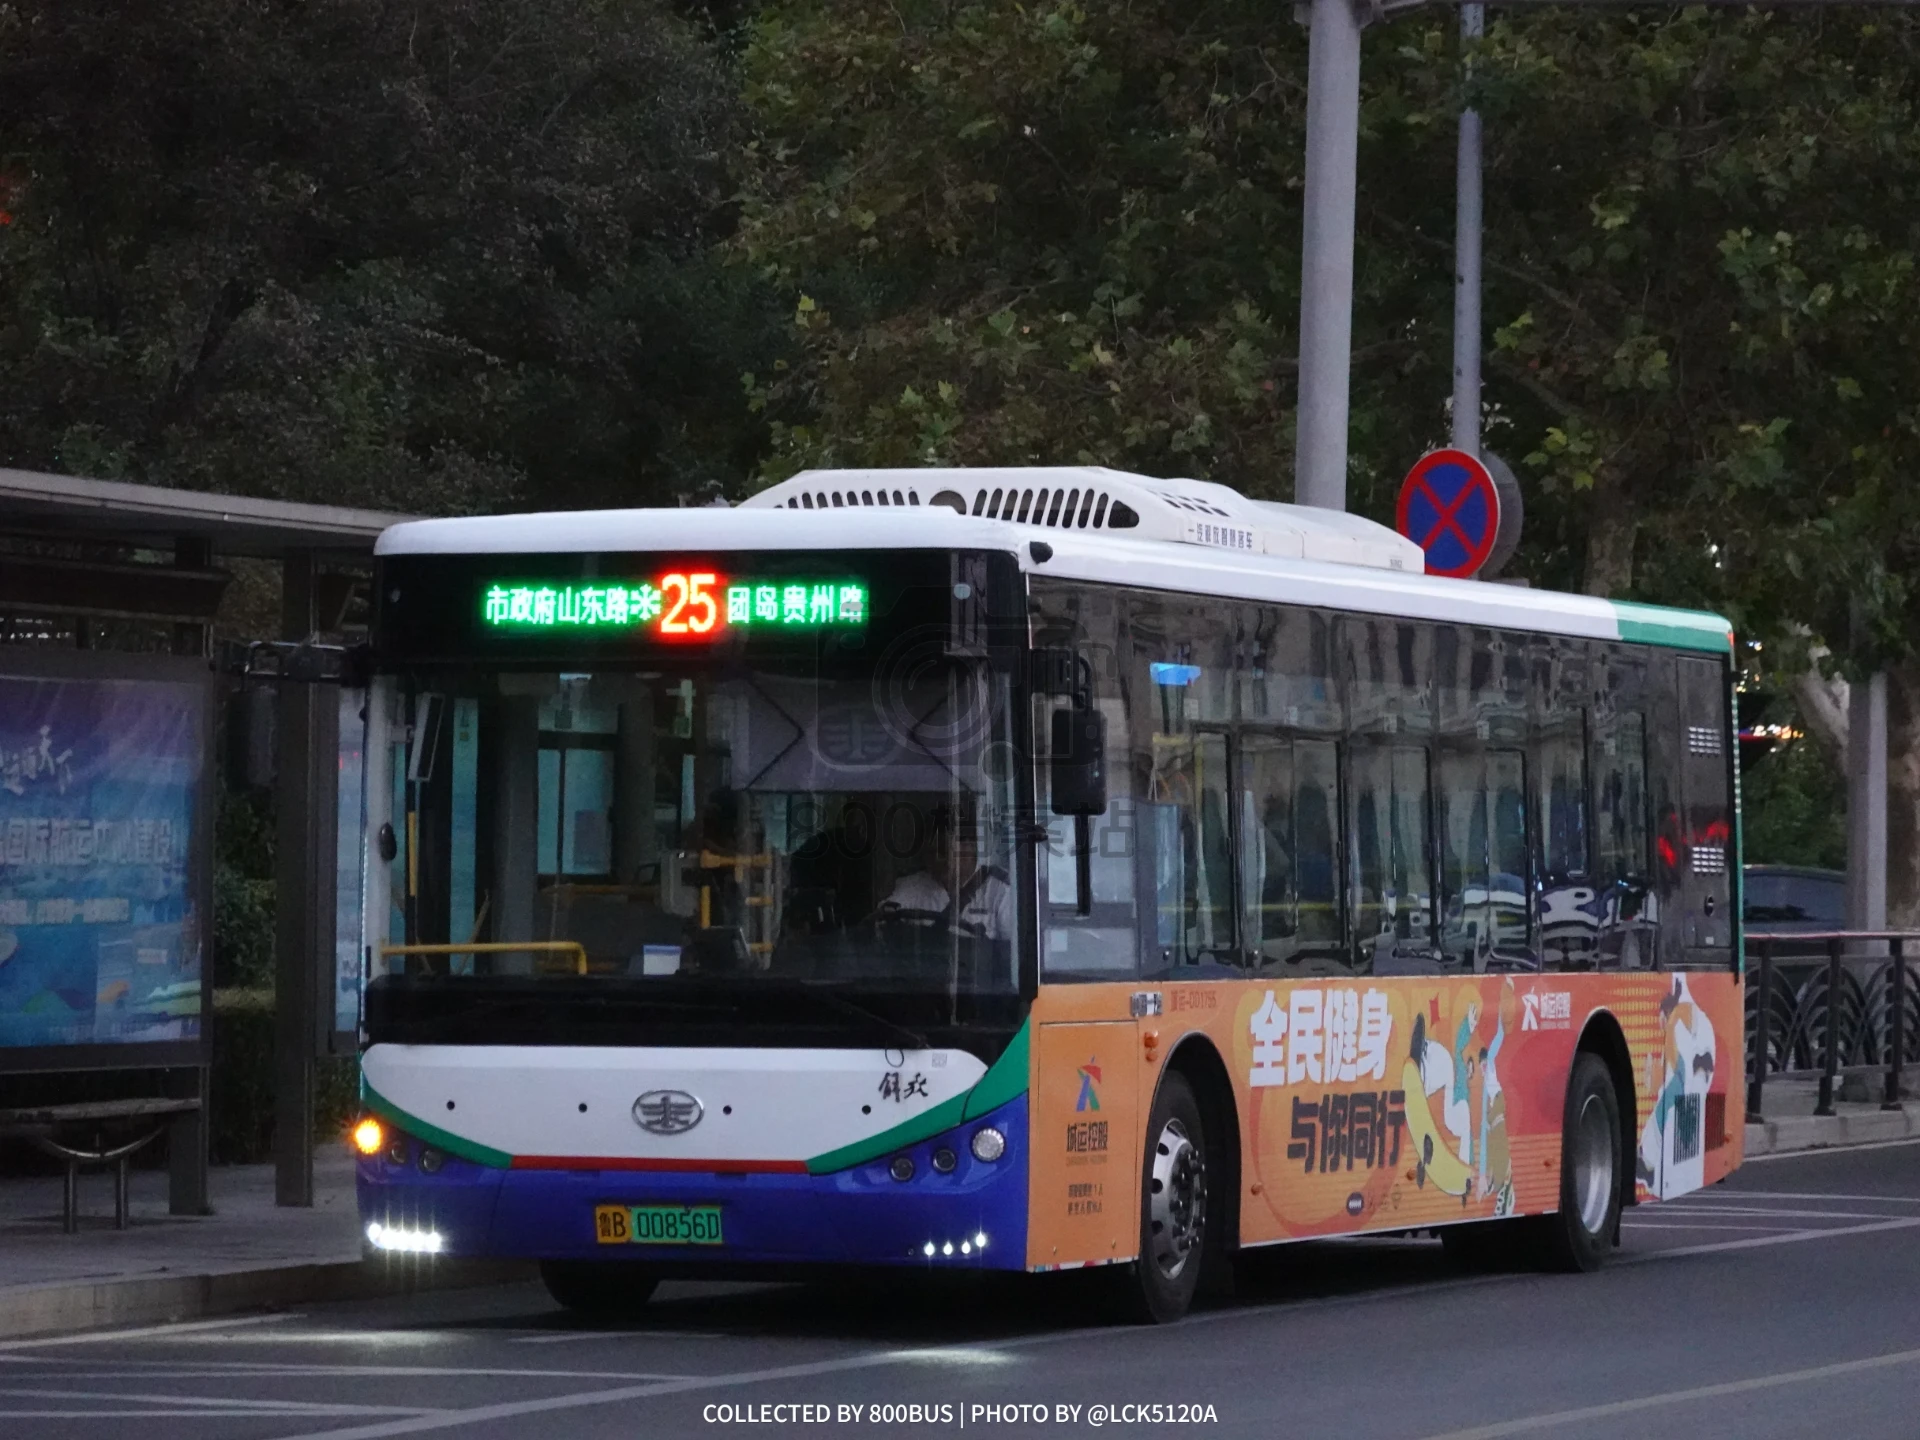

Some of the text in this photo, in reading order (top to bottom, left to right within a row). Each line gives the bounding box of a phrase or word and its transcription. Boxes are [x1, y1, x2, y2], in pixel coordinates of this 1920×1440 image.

[486, 573, 863, 633] 市政府山东路 25 团岛贵州路
[1249, 988, 1393, 1087] 全民健身
[1066, 1121, 1108, 1152] 城运控股
[1287, 1090, 1406, 1174] 与你同行
